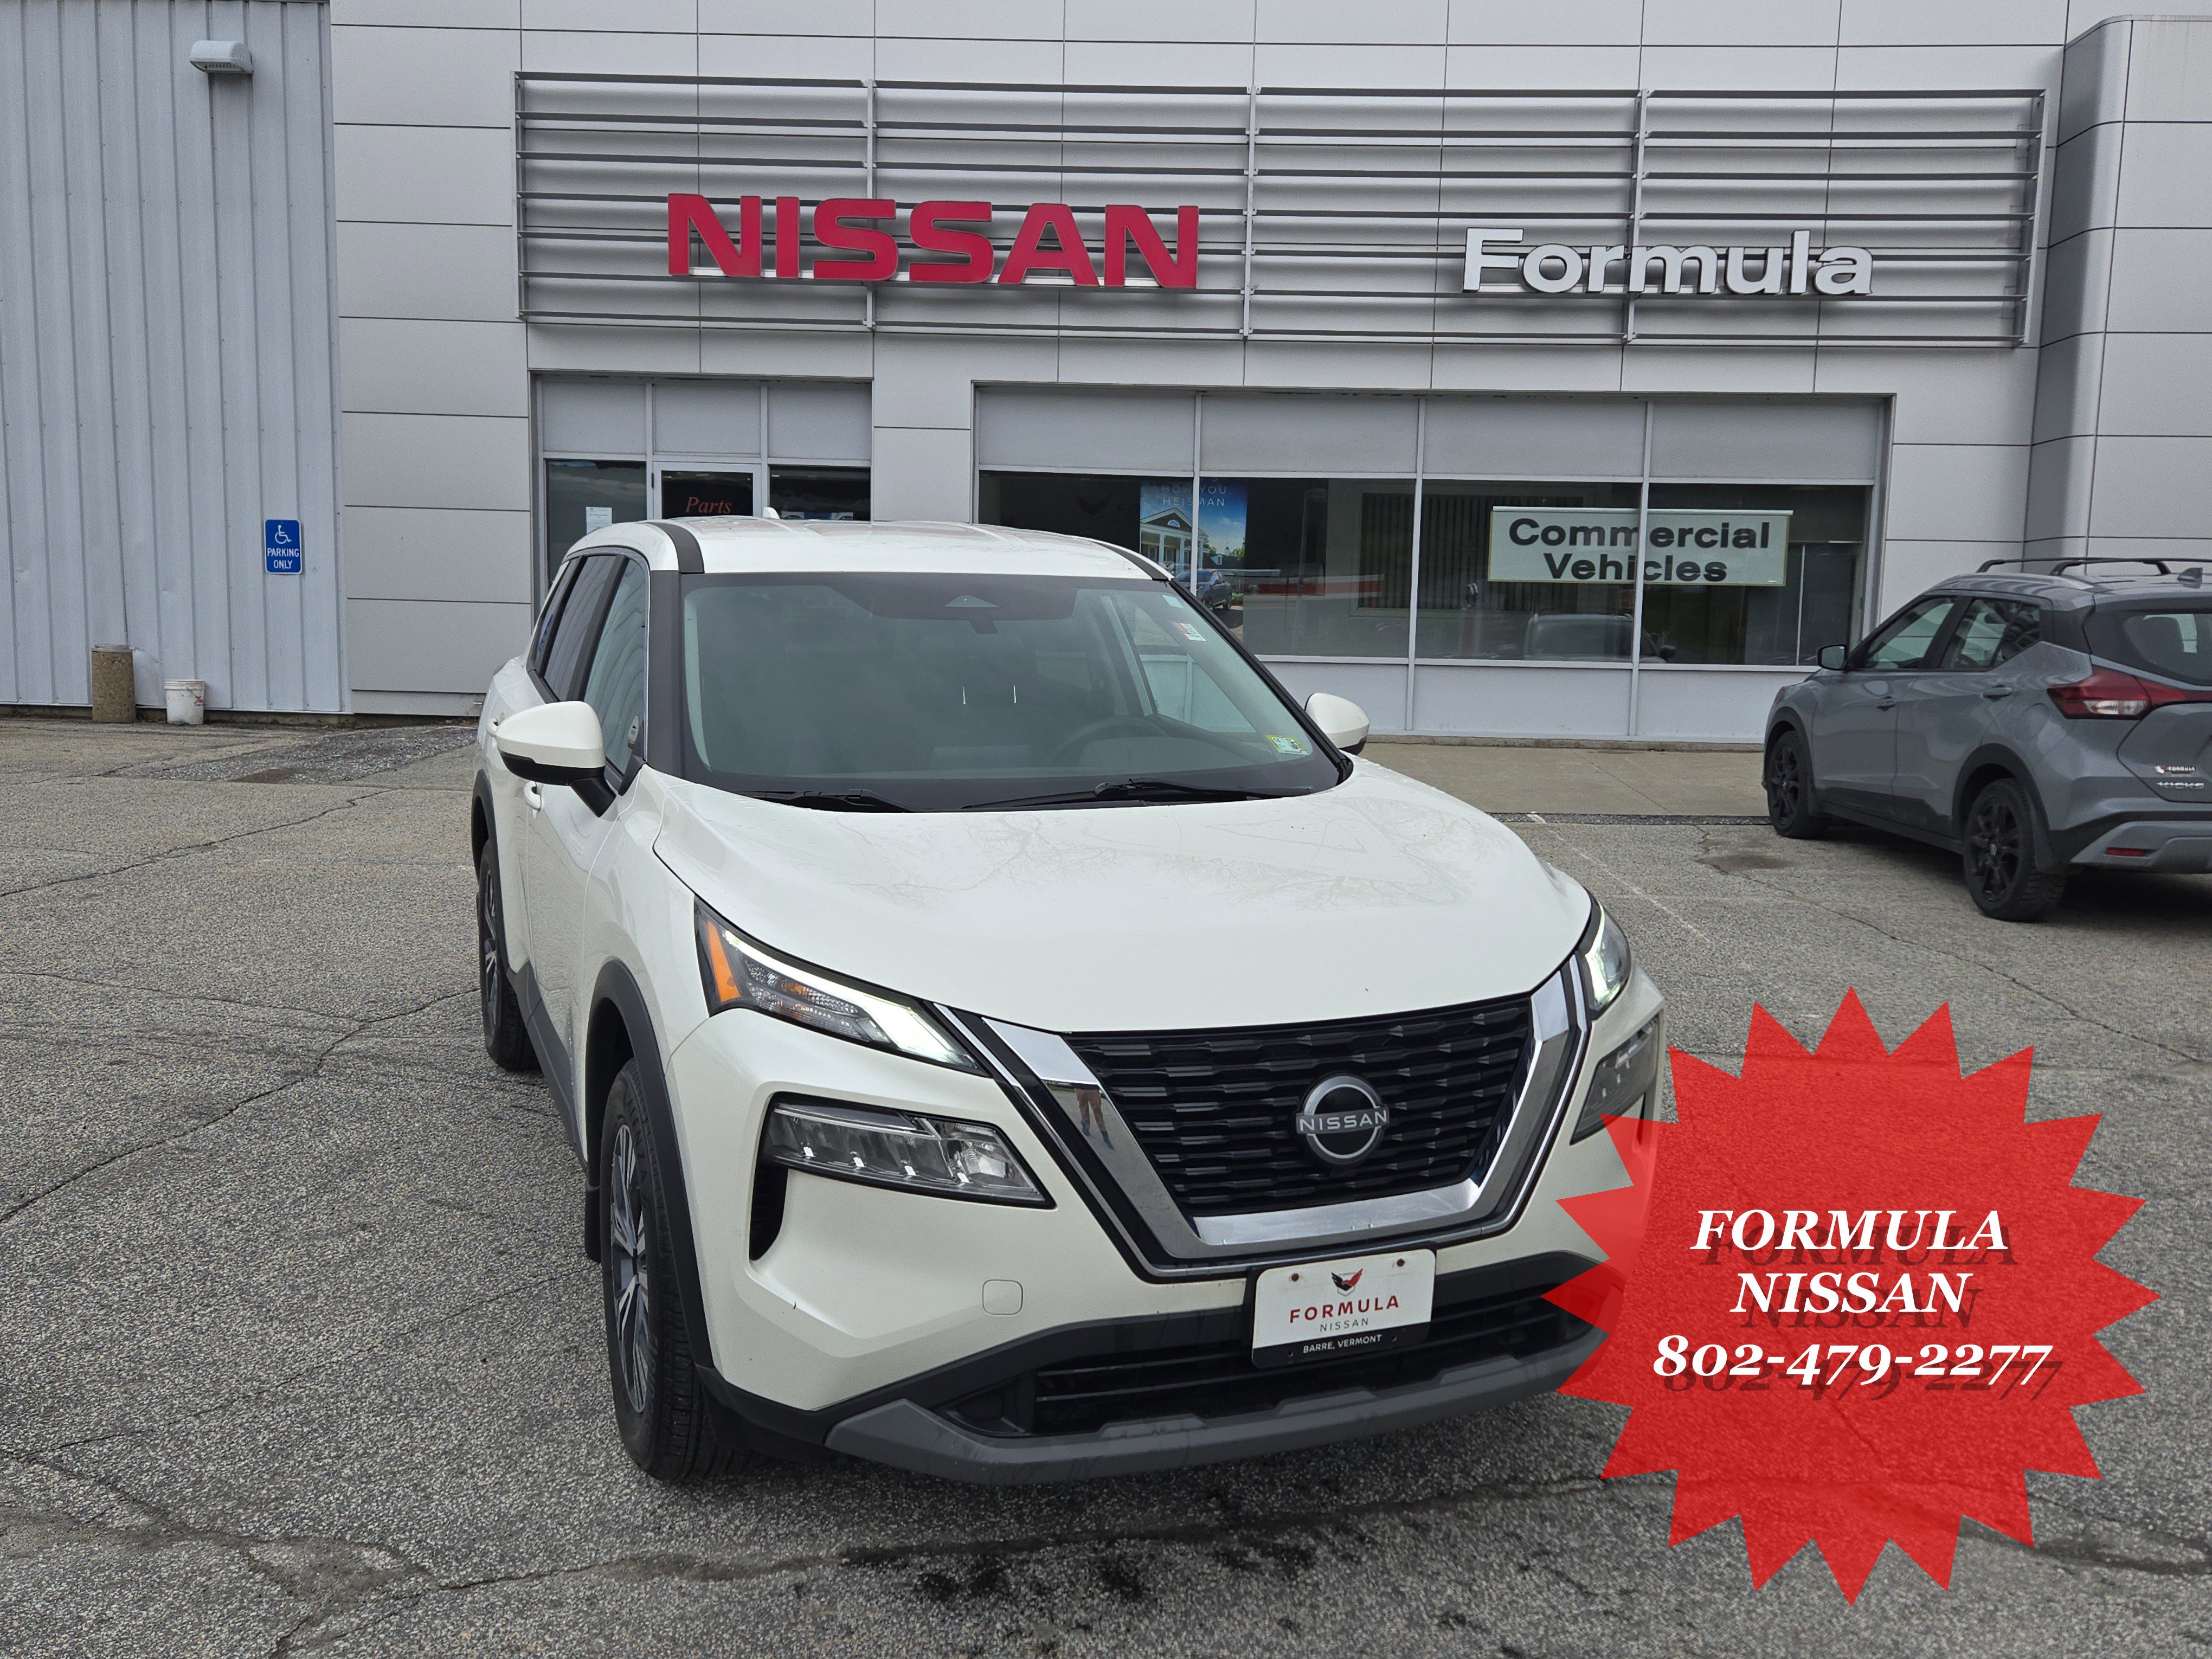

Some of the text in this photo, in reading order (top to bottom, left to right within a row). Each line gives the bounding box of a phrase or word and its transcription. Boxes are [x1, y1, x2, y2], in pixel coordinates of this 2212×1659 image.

[667, 193, 1199, 288] NISSAN
[1462, 228, 1873, 295] Formula
[1200, 485, 1226, 494] YOU
[685, 497, 732, 513] Parts
[1509, 518, 1770, 549] Commercial
[267, 548, 299, 557] PARKING
[273, 560, 293, 569] ONLY
[1544, 552, 1727, 582] Vehicles
[1299, 1109, 1387, 1131] NISSAN
[1289, 1295, 1399, 1323] FORMULA
[1320, 1317, 1369, 1332] NISSAN
[1303, 1334, 1382, 1354] BARRE, VERMONT
